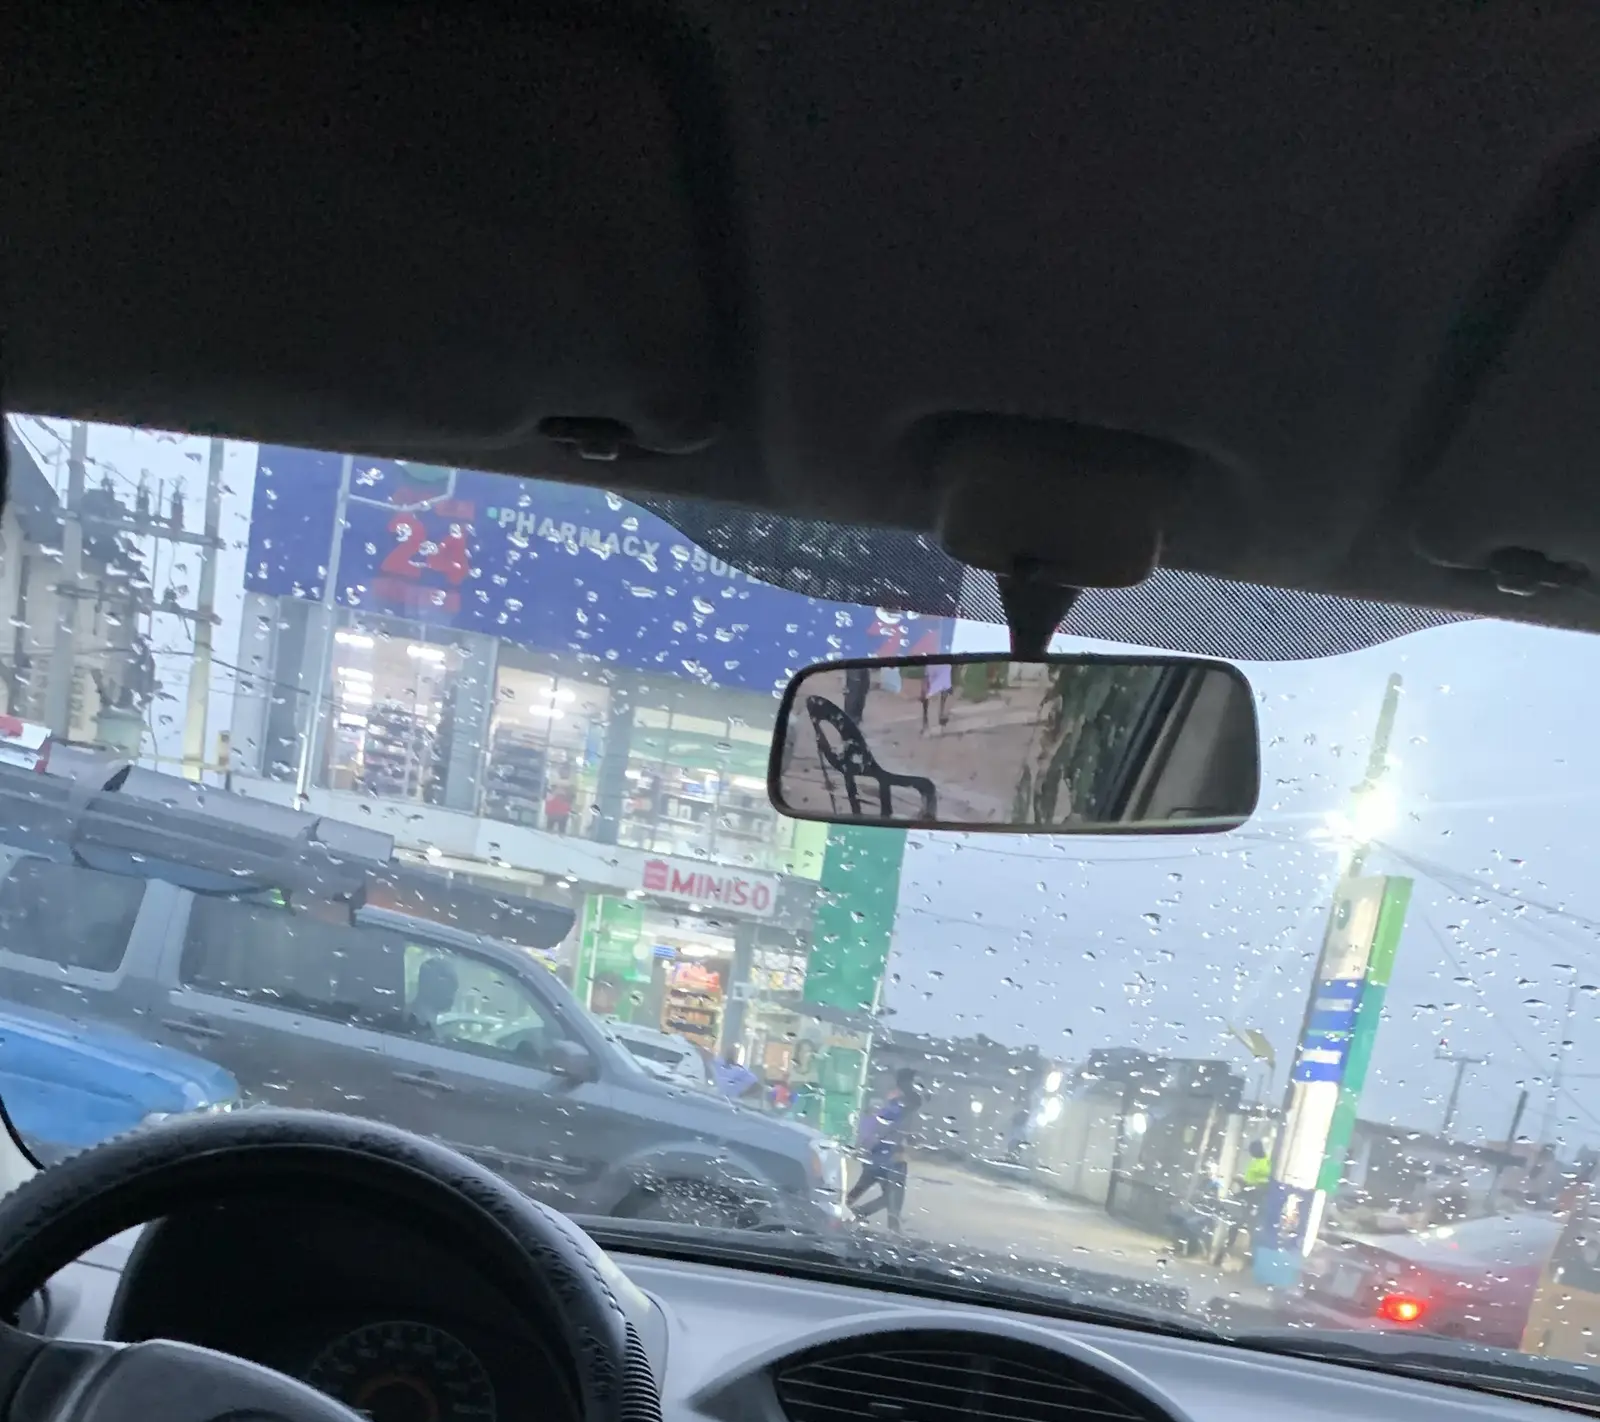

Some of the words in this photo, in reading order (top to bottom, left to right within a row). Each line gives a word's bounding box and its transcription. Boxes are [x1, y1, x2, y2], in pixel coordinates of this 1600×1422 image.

[380, 512, 470, 585] 24
[499, 507, 660, 559] PHARMACY
[671, 868, 770, 911] MINISO
